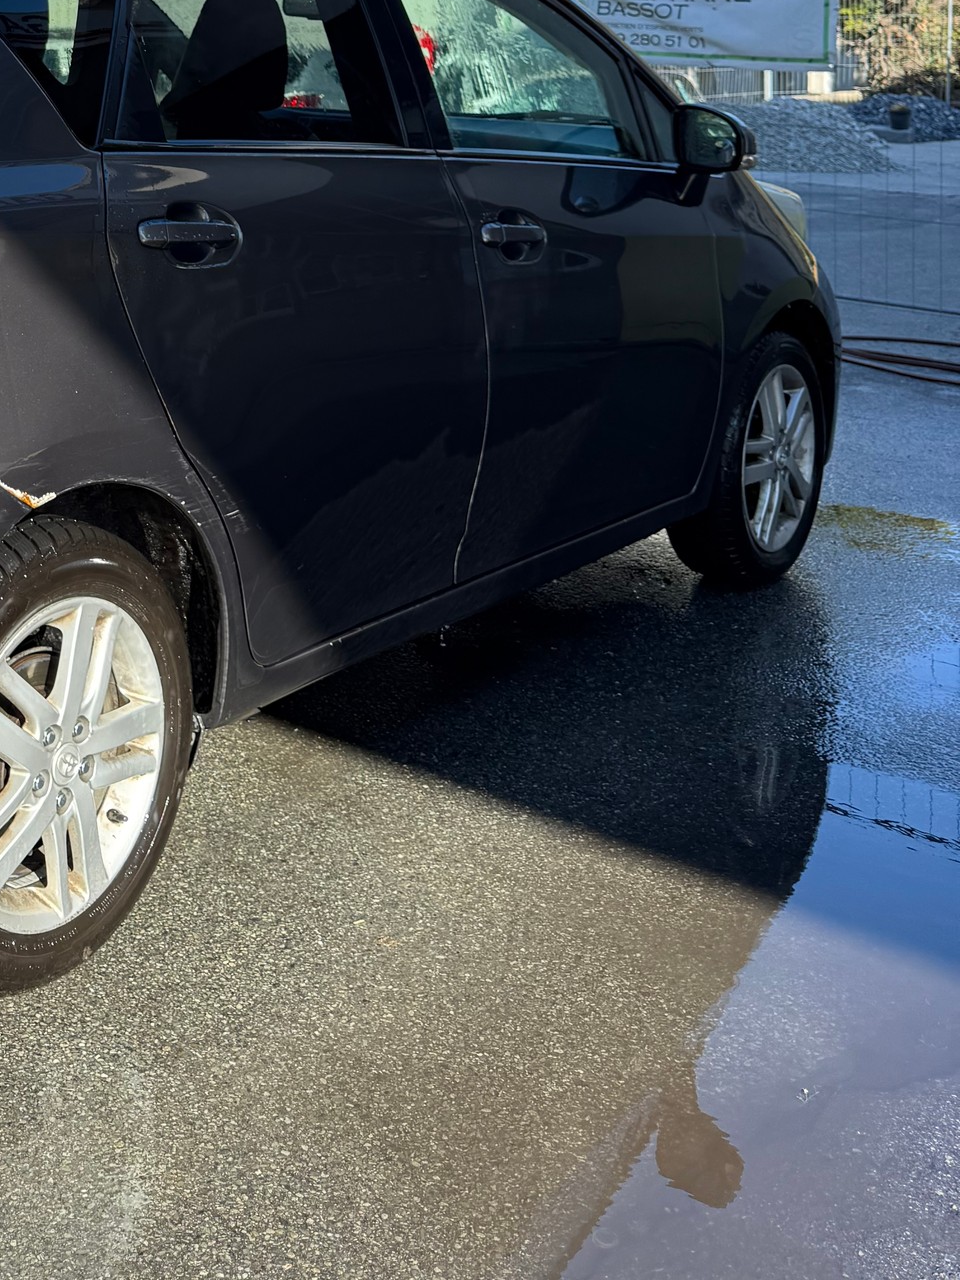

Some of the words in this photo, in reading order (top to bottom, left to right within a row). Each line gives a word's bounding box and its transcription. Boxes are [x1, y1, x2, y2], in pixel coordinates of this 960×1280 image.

[596, 0, 689, 20] BASSOT
[629, 32, 661, 47] 280
[664, 34, 682, 48] 51
[687, 35, 706, 49] 01
